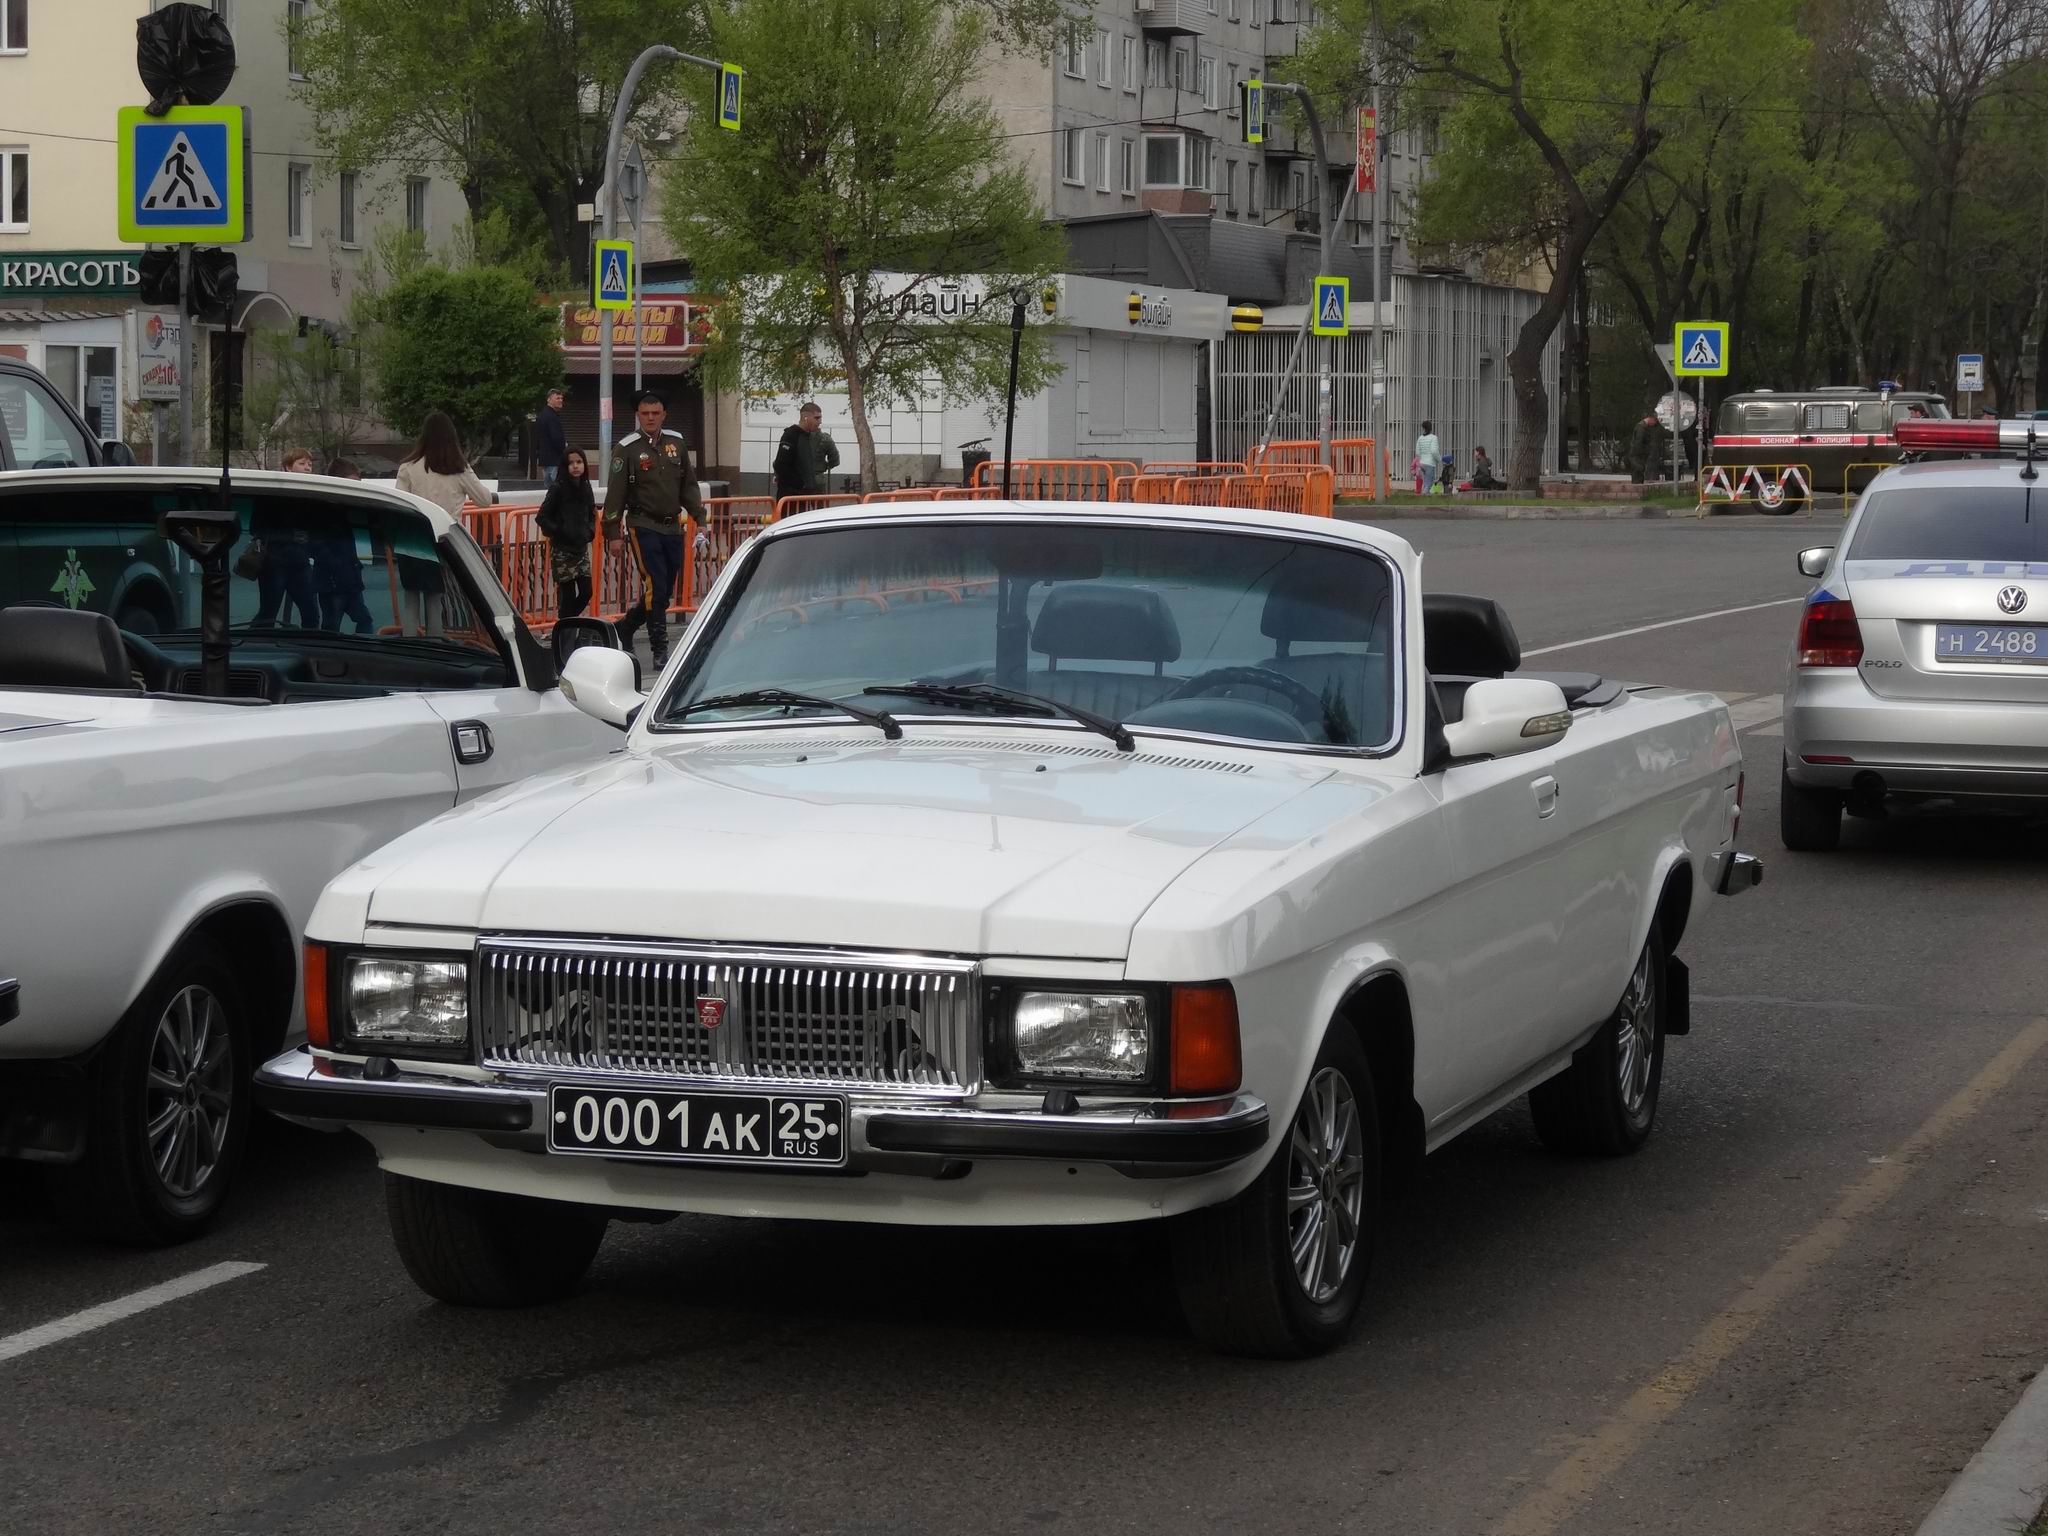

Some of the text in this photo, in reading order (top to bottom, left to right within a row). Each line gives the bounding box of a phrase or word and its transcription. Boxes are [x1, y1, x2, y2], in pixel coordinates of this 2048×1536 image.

[1760, 436, 1852, 445] ВОЕННАЯ ПОЛИЦИЯ
[1974, 630, 2038, 654] 2488
[1864, 660, 1903, 668] POLO
[573, 1095, 690, 1148] 0001
[778, 1102, 827, 1141] 25
[783, 1141, 819, 1156] RUS
